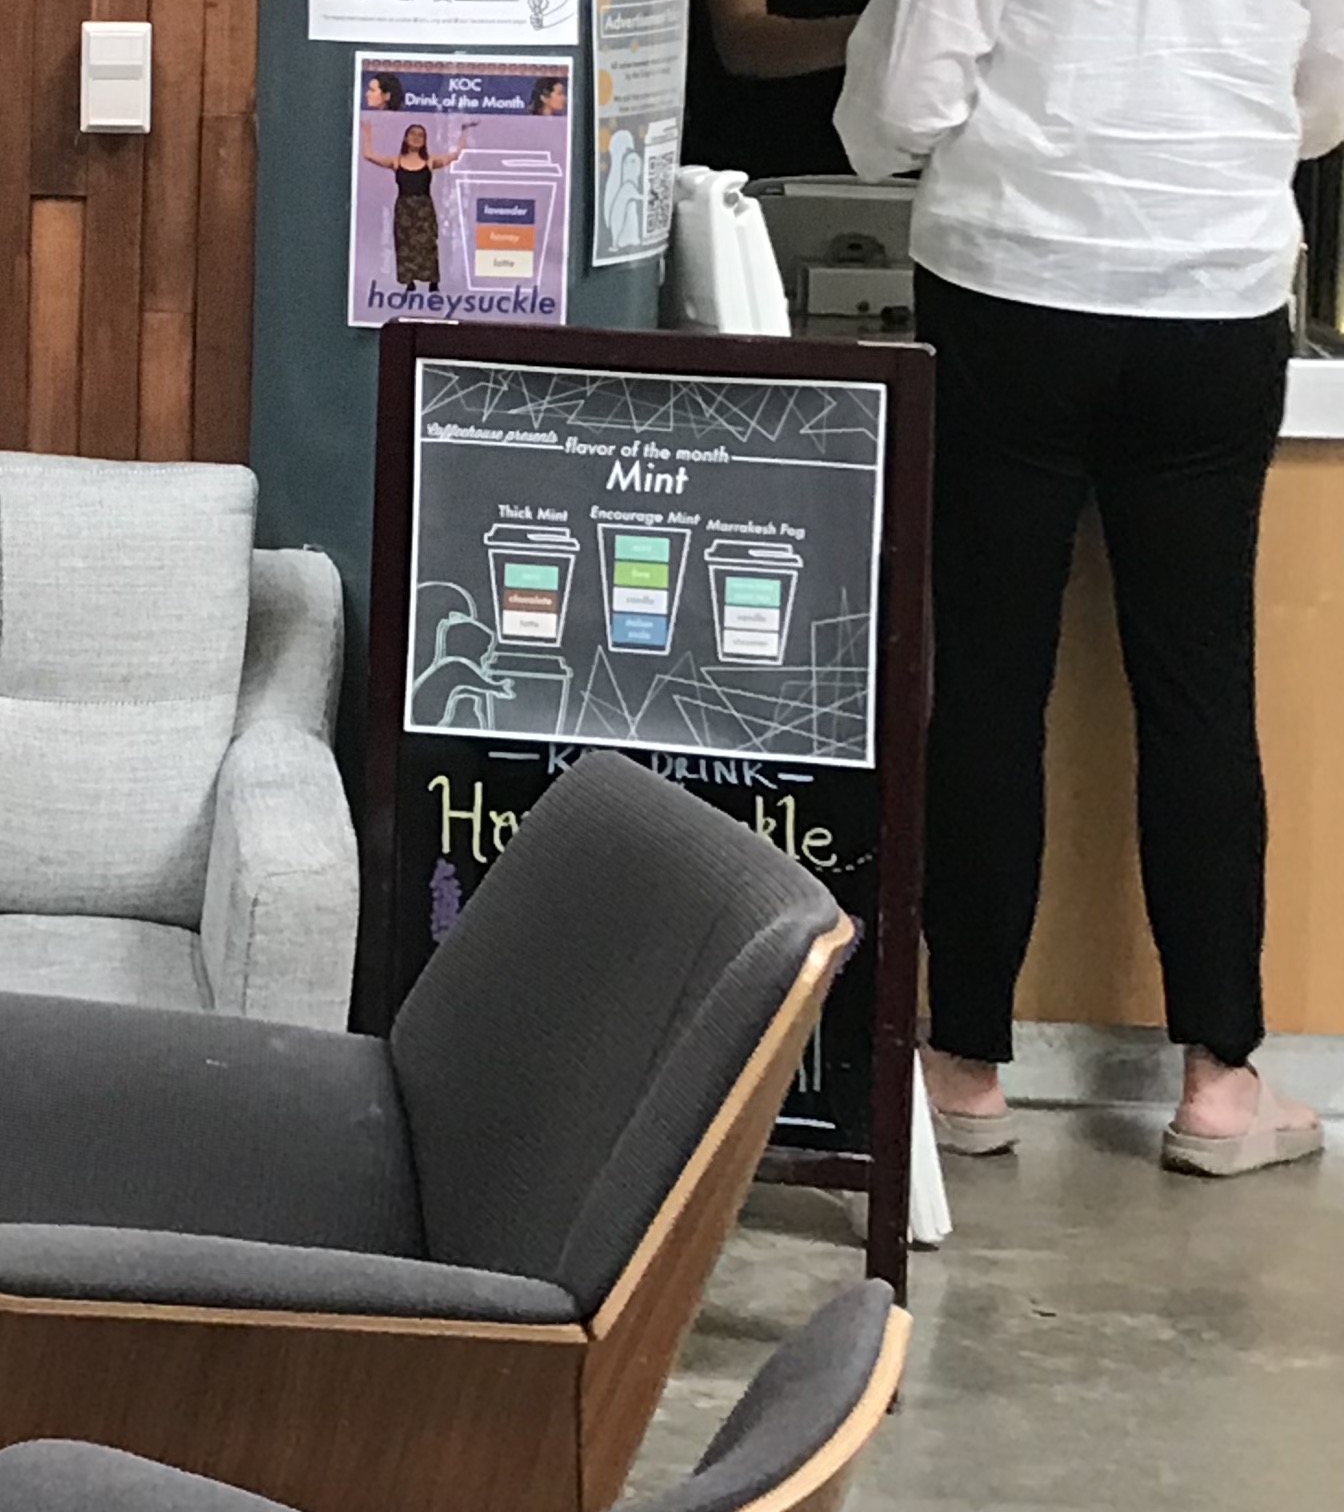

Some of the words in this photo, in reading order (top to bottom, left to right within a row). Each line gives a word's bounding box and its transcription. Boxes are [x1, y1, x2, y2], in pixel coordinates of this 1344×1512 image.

[448, 78, 482, 92] KOC
[405, 93, 439, 106] Drink
[443, 93, 457, 106] of
[458, 94, 479, 108] the
[482, 95, 525, 109] Month
[367, 280, 556, 319] honeysuckle
[565, 437, 613, 456] flavor
[620, 440, 641, 457] of
[643, 441, 671, 460] the
[676, 446, 730, 464] month
[605, 459, 690, 494] Mint
[498, 505, 533, 520] Thick
[537, 507, 568, 522] Mint
[589, 505, 663, 526] Encourage
[668, 511, 700, 526] Mint
[706, 519, 776, 536] Marrakesh
[651, 752, 779, 790] DRINK
